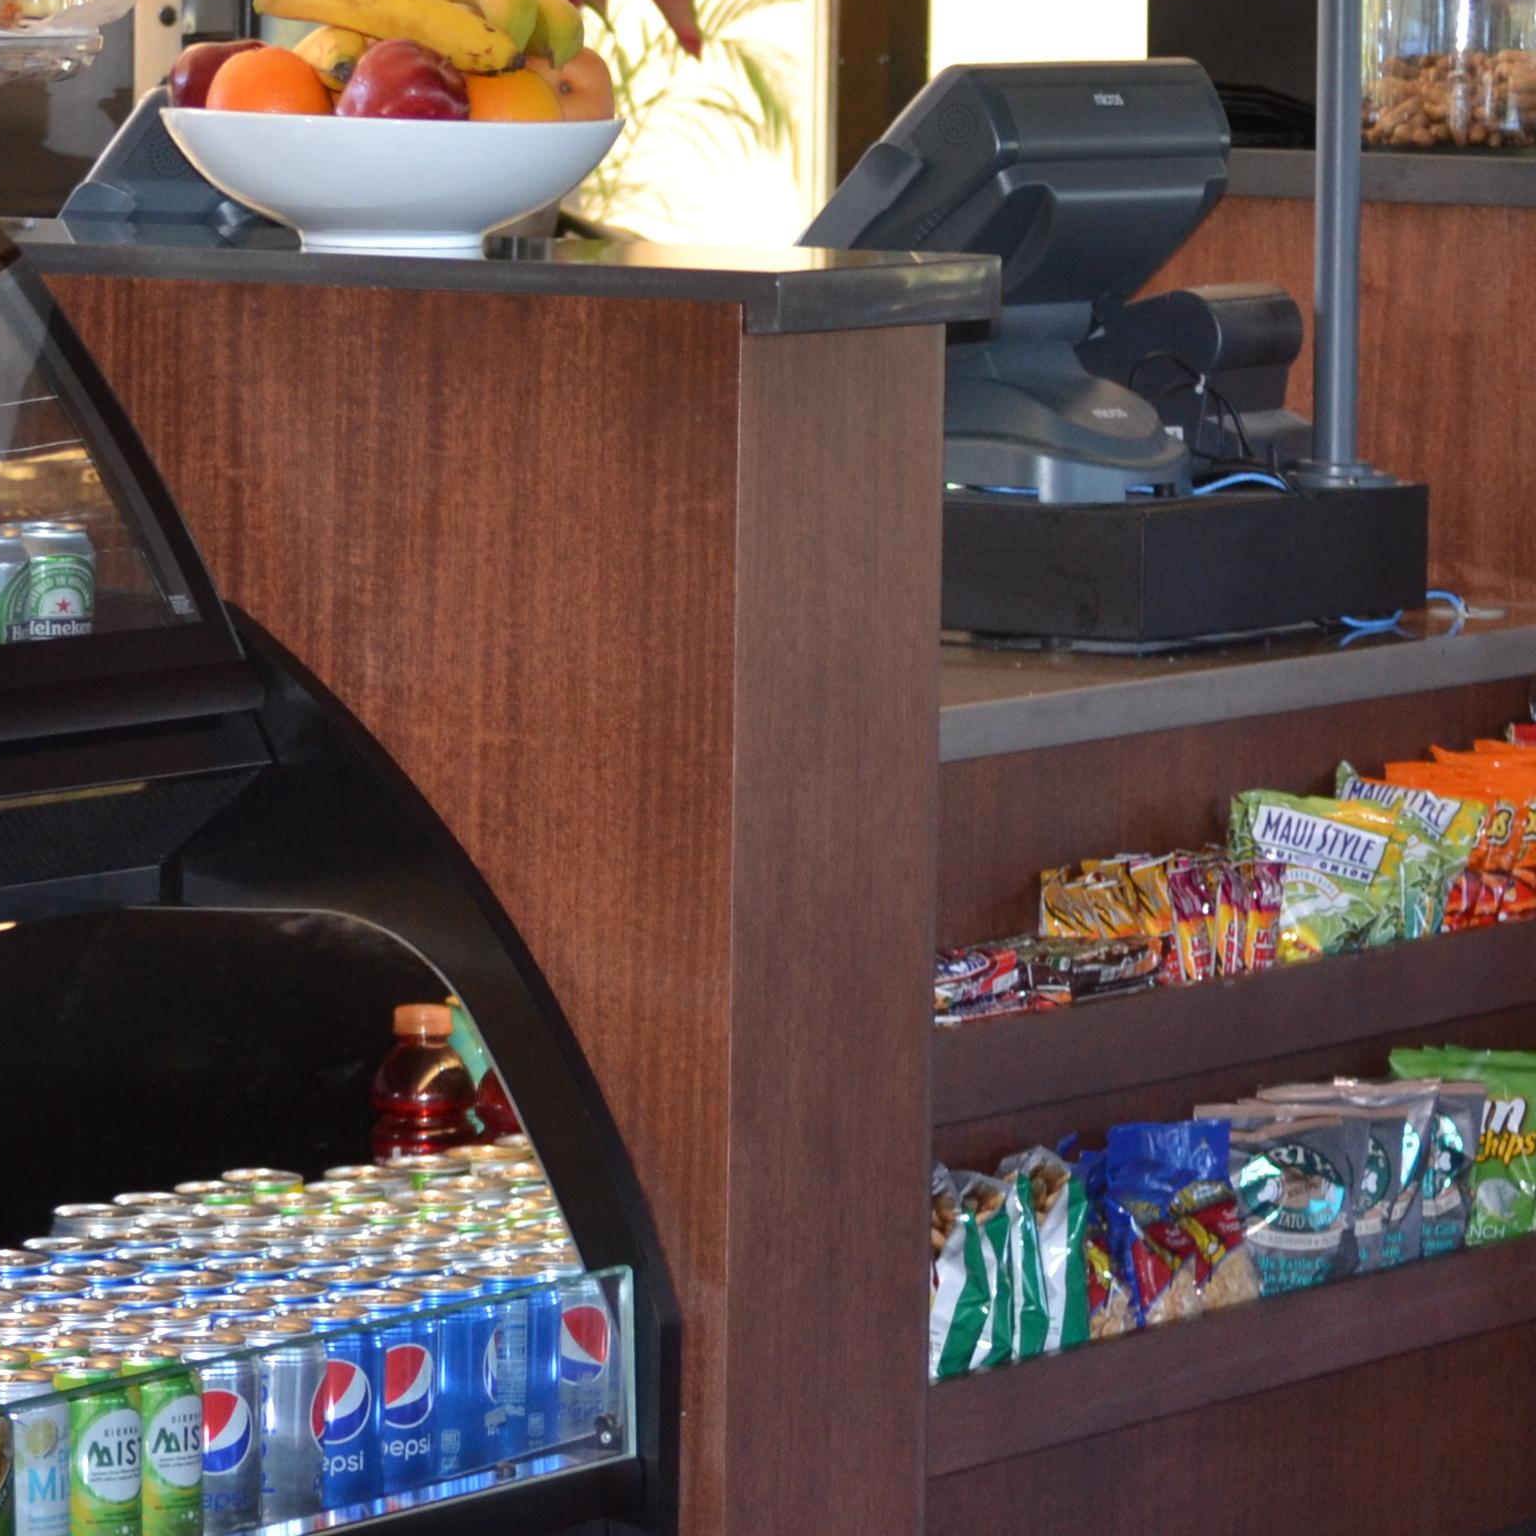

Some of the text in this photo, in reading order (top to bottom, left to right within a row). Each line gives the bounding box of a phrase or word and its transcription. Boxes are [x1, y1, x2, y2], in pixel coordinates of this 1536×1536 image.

[1093, 90, 1125, 107] micros
[1262, 811, 1378, 865] MAUI STYLE
[1319, 861, 1370, 880] ONION
[322, 1451, 364, 1477] epsi
[202, 1490, 249, 1510] epsi
